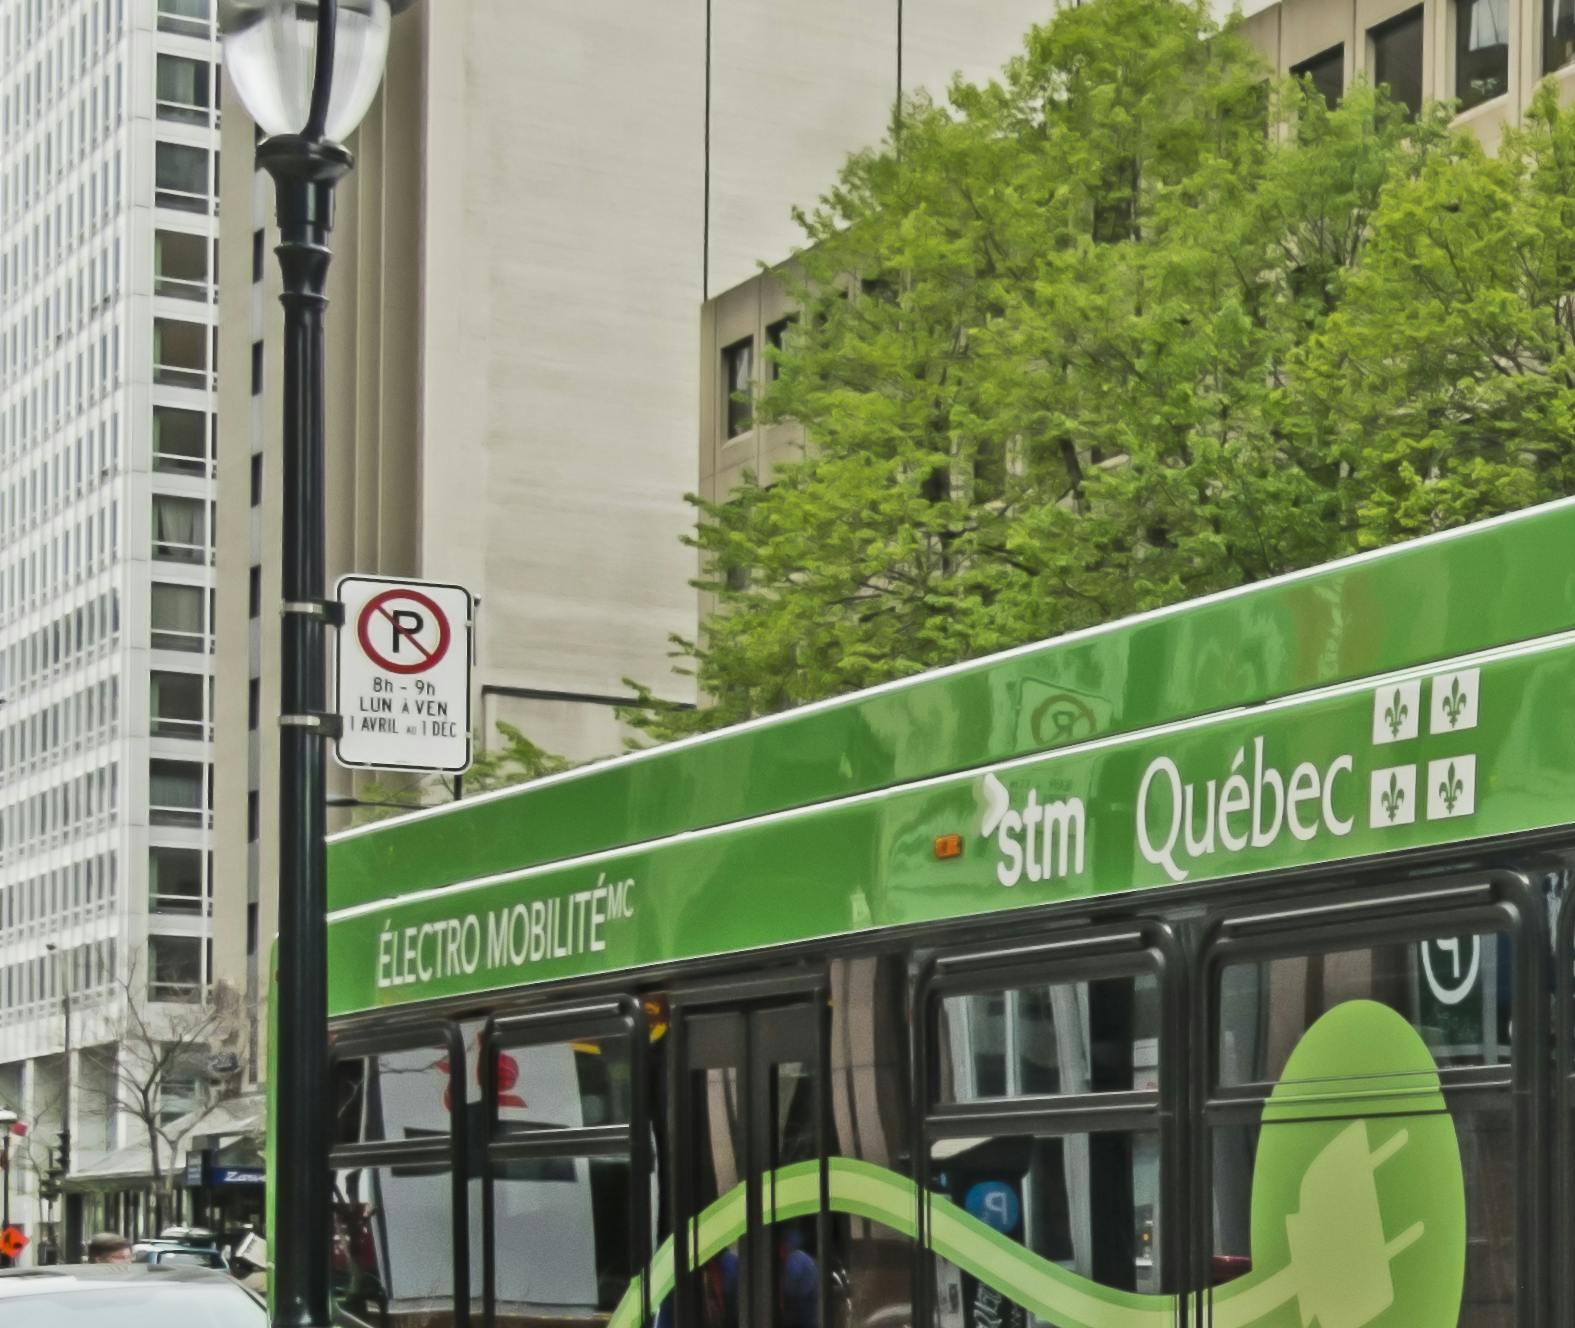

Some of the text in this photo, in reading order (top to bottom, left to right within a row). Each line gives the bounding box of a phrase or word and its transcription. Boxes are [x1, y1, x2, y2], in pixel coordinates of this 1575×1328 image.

[360, 696, 392, 713] LUN
[416, 700, 447, 716] VEN
[373, 677, 393, 693] 8h
[415, 680, 435, 696] 9h
[361, 717, 400, 734] AVRIL
[432, 721, 457, 737] DEC
[1136, 735, 1355, 882] Québec
[997, 784, 1086, 887] stm
[377, 918, 480, 988] ÉLECTRO
